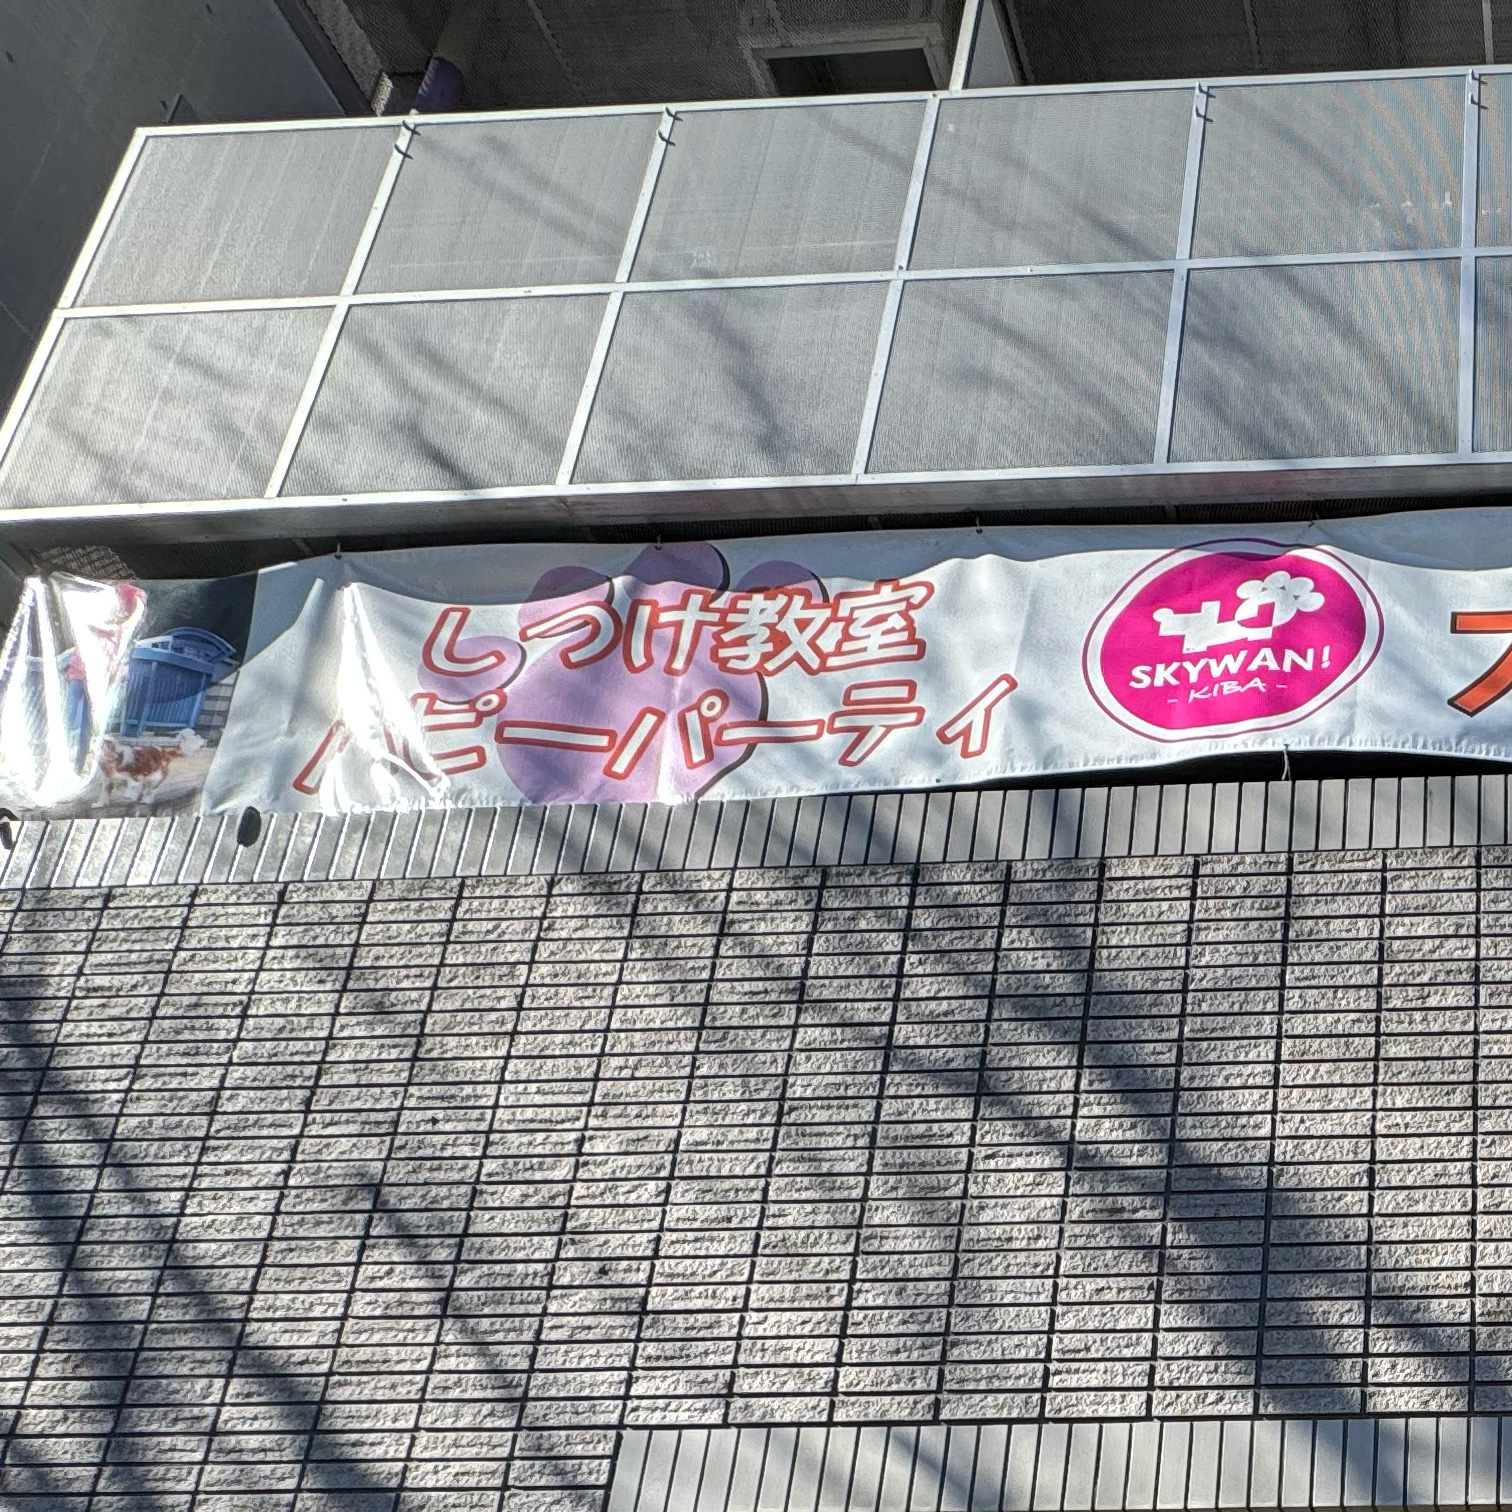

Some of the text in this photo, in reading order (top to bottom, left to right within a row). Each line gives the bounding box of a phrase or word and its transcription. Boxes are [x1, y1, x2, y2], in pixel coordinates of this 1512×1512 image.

[421, 578, 934, 677] しつけ教室
[1129, 645, 1331, 689] SKYWAN!
